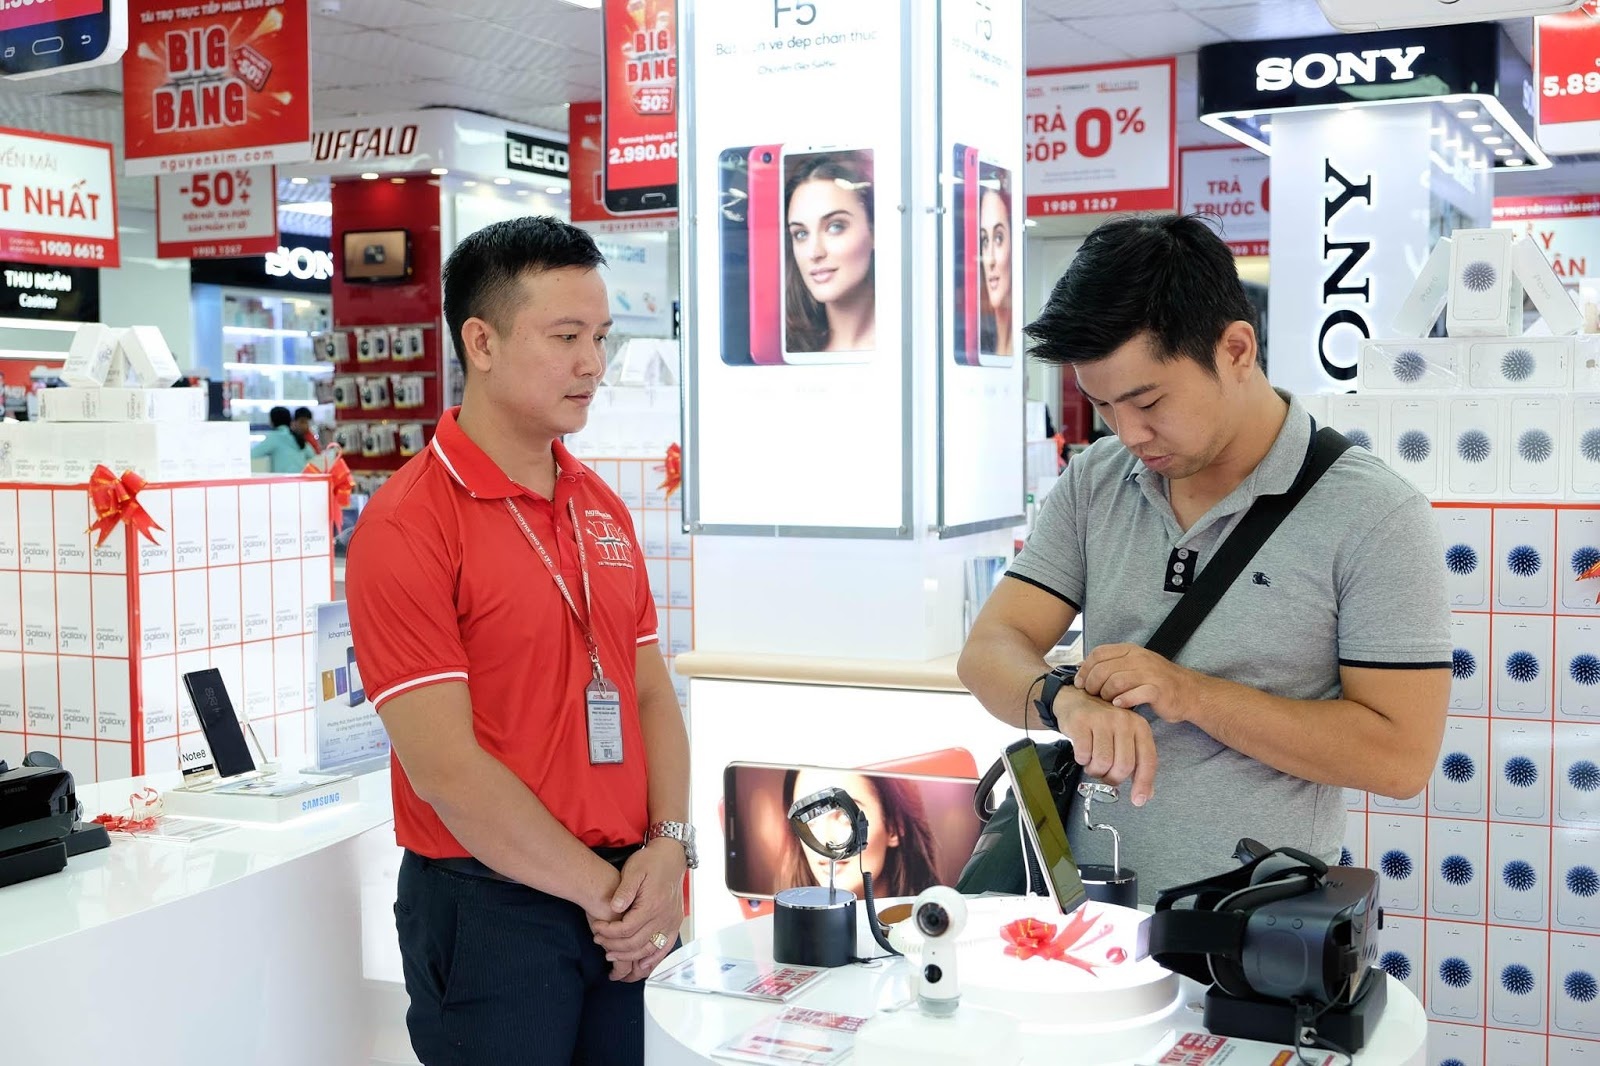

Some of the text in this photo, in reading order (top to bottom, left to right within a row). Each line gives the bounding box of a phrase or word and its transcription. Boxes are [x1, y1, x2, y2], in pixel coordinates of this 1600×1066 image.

[634, 30, 670, 53] BIG
[166, 25, 229, 76] BIG
[1255, 46, 1425, 92] SONY
[153, 79, 247, 133] BANG
[312, 125, 418, 162] UFFALO
[160, 151, 274, 170] nguyenkim.com
[24, 179, 99, 220] NHẤT
[1043, 199, 1077, 213] 1900
[4, 270, 72, 292] THU NGÂN
[1318, 158, 1371, 394] ONY
[274, 537, 296, 545] Galaxy
[304, 534, 326, 542] Galaxy
[211, 543, 235, 552] Galaxy
[243, 539, 266, 549] Galaxy
[23, 548, 49, 557] Galaxy
[58, 548, 85, 558] Galaxy
[94, 549, 121, 559] Galaxy
[141, 549, 168, 558] Galaxy
[177, 546, 202, 555] Galaxy
[245, 618, 268, 627] Galaxy
[275, 613, 298, 623] Galaxy
[179, 627, 204, 637] Galaxy
[212, 622, 237, 632] Galaxy
[25, 629, 51, 639] Galaxy
[60, 631, 87, 641] Galaxy
[96, 633, 123, 643] Galaxy
[143, 631, 170, 641] Galaxy
[28, 711, 54, 721] Galaxy
[63, 713, 90, 723] Galaxy
[146, 714, 173, 724] Galaxy
[99, 716, 126, 727] Galaxy
[182, 749, 206, 762] Note8
[302, 792, 340, 811] SAMSUNG
